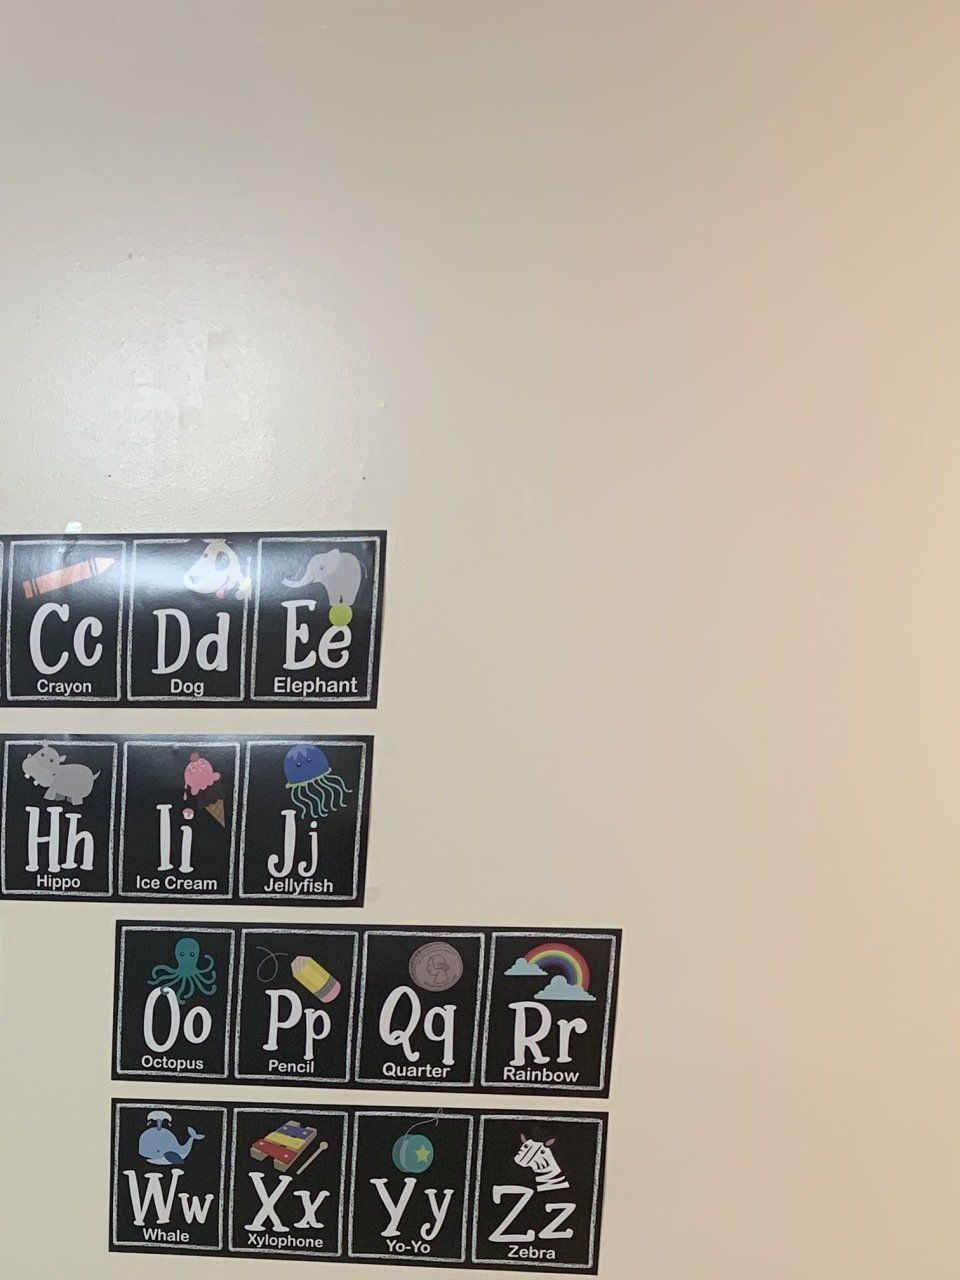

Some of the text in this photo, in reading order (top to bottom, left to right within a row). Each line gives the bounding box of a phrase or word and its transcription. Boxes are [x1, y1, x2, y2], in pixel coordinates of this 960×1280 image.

[29, 603, 104, 674] Cc
[152, 608, 230, 674] Dd
[281, 600, 352, 671] Ee
[36, 679, 92, 696] Crayon
[170, 679, 204, 696] Dog
[274, 676, 358, 696] Elephant
[24, 806, 94, 873] Hh
[156, 804, 194, 873] Ii
[268, 810, 319, 876] Jj
[36, 874, 80, 890] Hippo
[136, 876, 218, 890] Ice Cream
[263, 876, 334, 894] Jellyfish
[143, 987, 212, 1052] Oo
[263, 989, 331, 1061] Pp
[378, 985, 457, 1065] Qq
[508, 1001, 588, 1066] Rr
[141, 1056, 204, 1070] Octopus
[268, 1060, 314, 1074] Pencil
[382, 1063, 450, 1078] Quarter
[503, 1067, 579, 1083] Rainbow
[124, 1169, 214, 1226] Ww
[245, 1172, 330, 1232] Xx
[370, 1178, 454, 1241] Yy
[488, 1185, 577, 1242] Zz
[143, 1229, 189, 1243] Whale
[247, 1234, 323, 1249] Xylophone
[386, 1240, 430, 1254] Yo-Yo
[508, 1246, 556, 1260] Zebra
